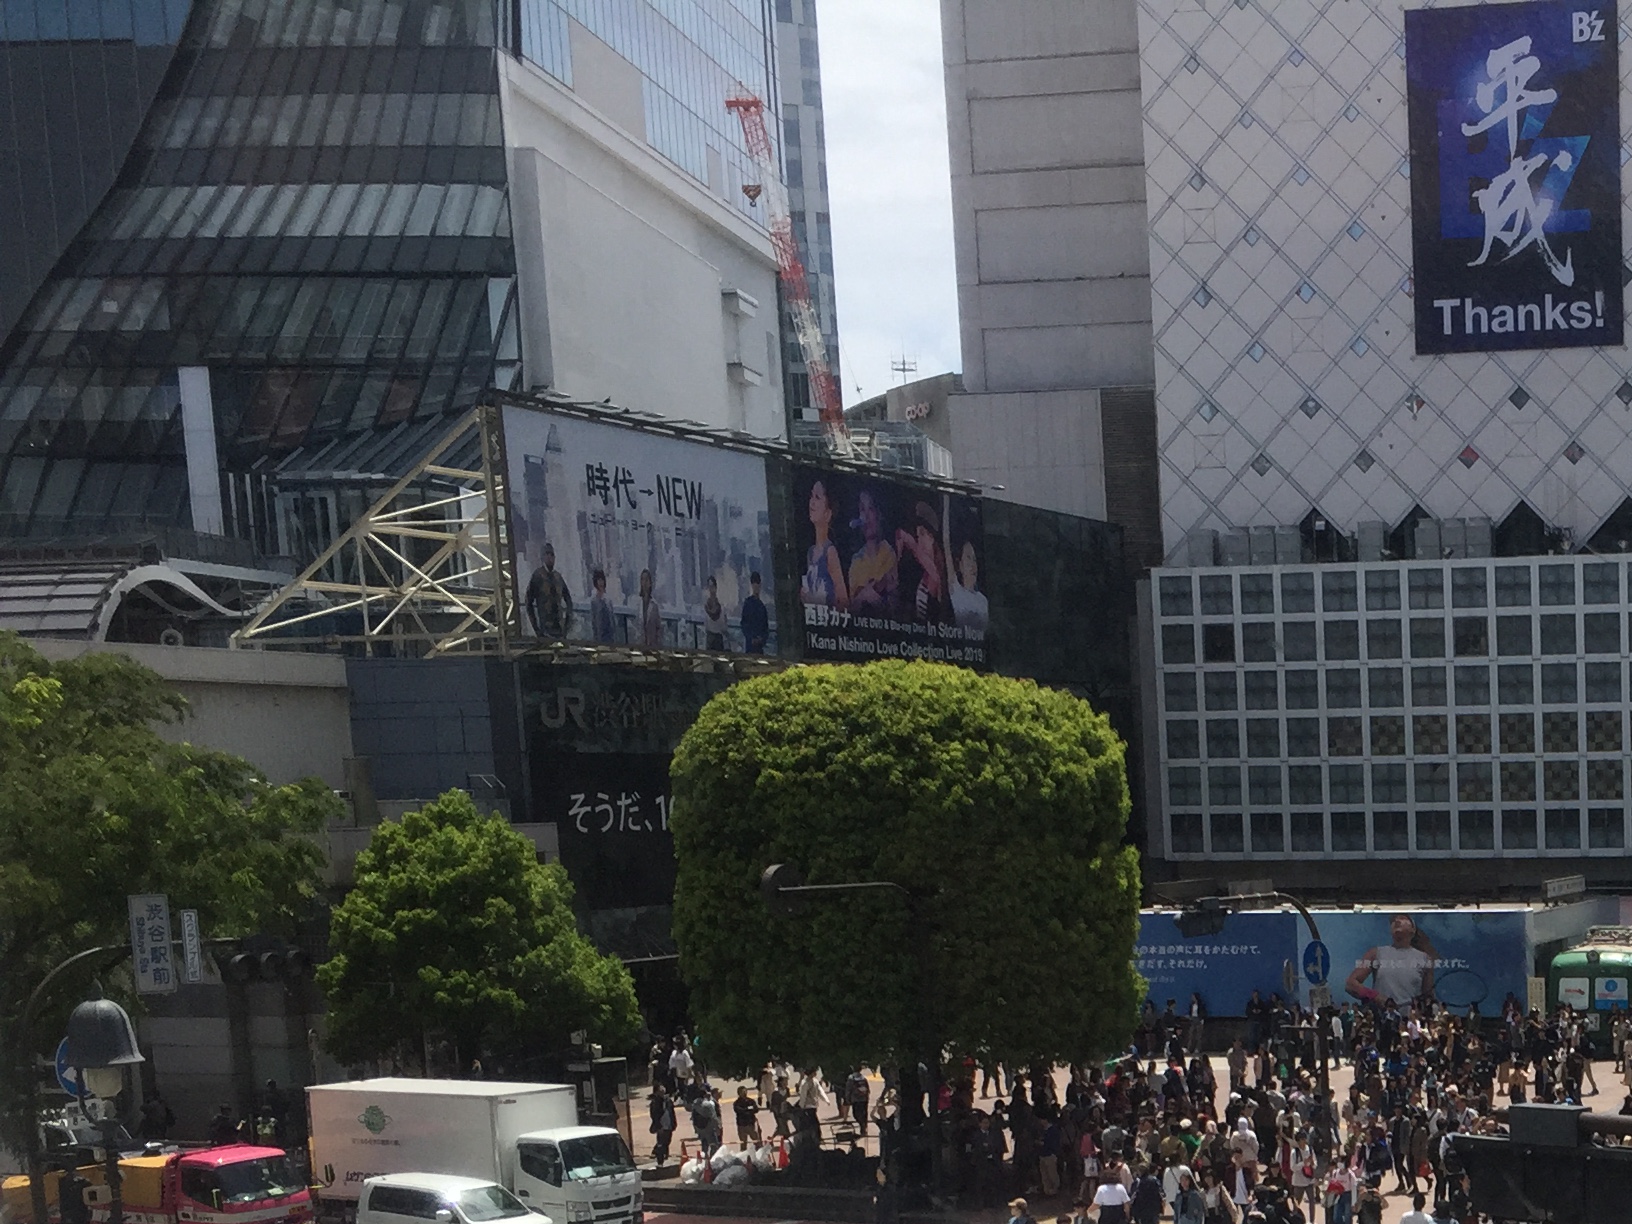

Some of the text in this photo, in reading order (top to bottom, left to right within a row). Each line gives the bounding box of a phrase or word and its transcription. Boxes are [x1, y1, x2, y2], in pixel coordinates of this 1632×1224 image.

[1571, 10, 1606, 43] B'z
[1461, 35, 1575, 287] 平成
[1433, 292, 1605, 337] Thanks!
[586, 462, 702, 520] 時代 NEW
[804, 603, 851, 628] 西野カナ
[927, 621, 937, 637] In
[938, 623, 963, 639] Store
[876, 640, 899, 656] Love
[146, 903, 170, 985] 渋谷駅前
